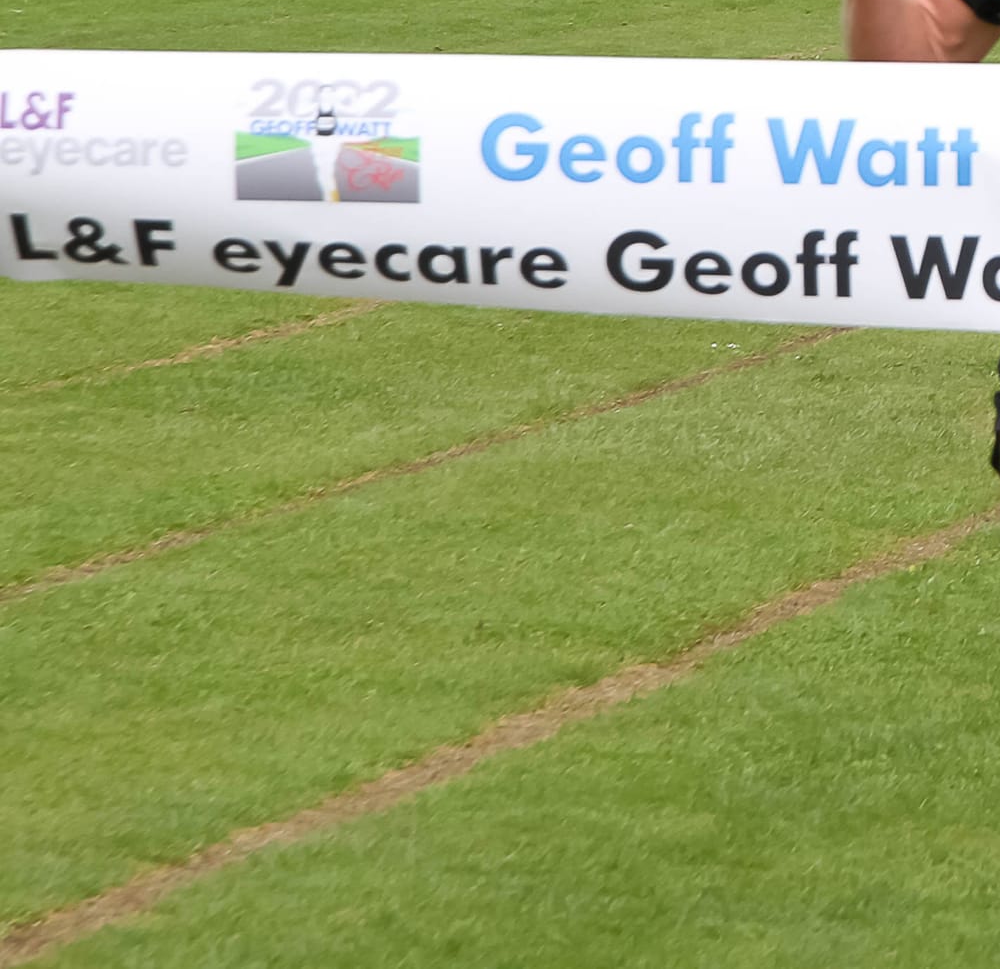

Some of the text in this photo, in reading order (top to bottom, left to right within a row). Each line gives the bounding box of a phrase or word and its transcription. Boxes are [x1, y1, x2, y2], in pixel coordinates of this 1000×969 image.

[0, 92, 75, 130] L&F
[334, 121, 393, 136] WATT
[0, 134, 188, 175] eyecare
[481, 113, 735, 184] Geoff
[768, 118, 979, 187] Watt
[10, 213, 175, 267] L&F
[213, 235, 568, 289] eyecare
[606, 230, 859, 298] Geoff
